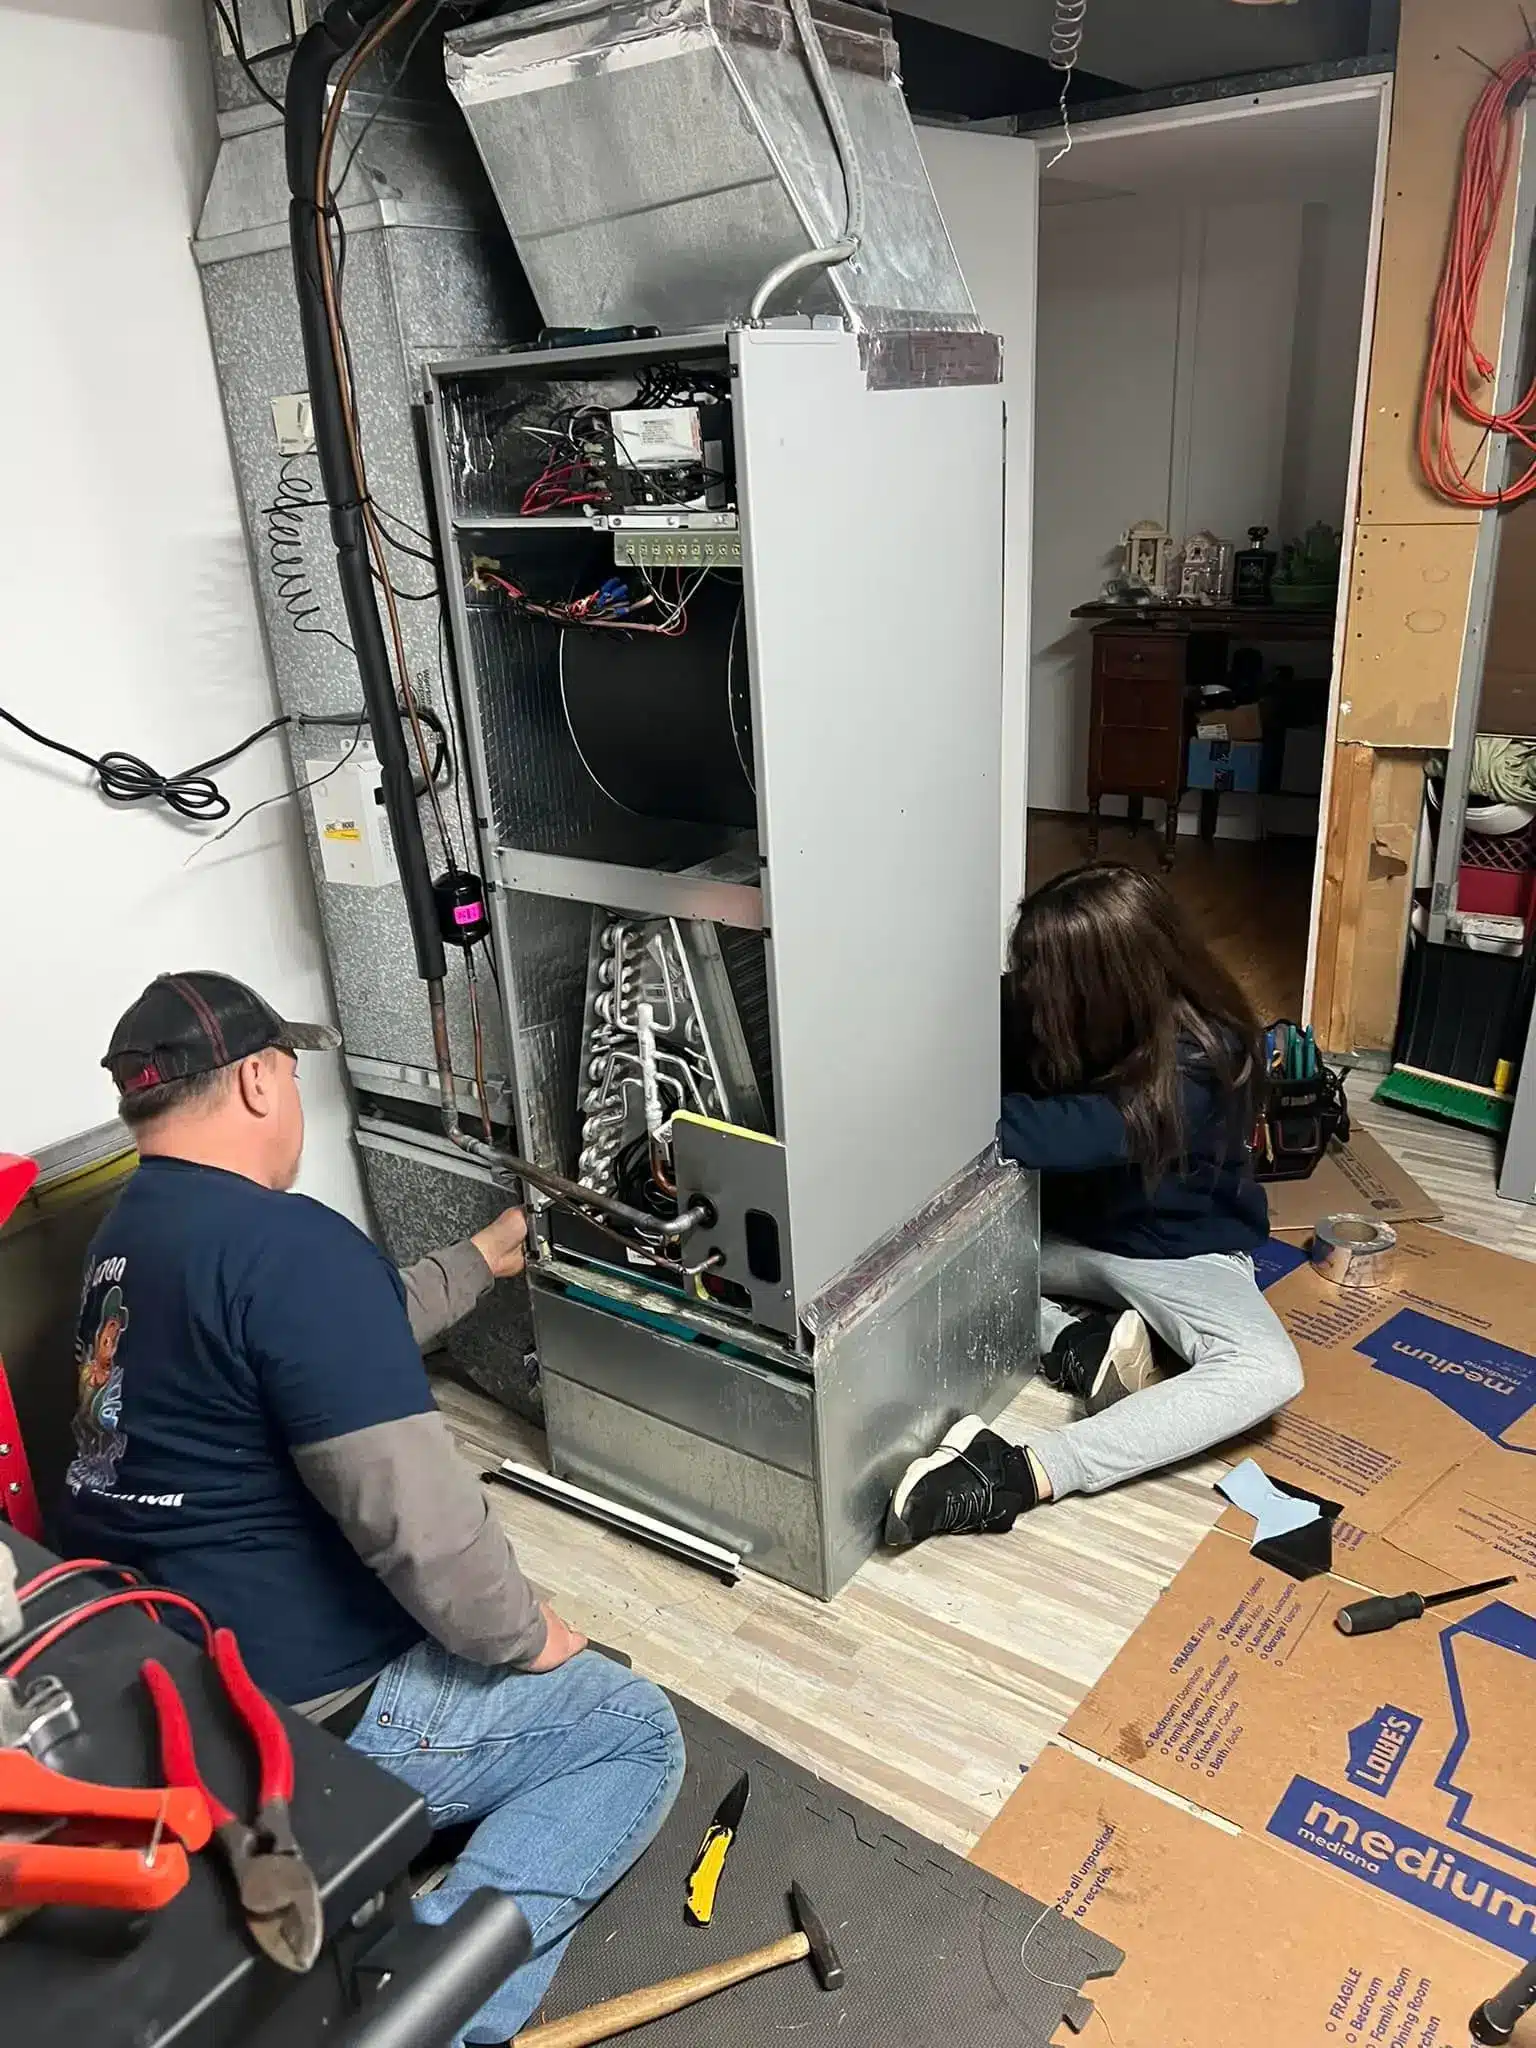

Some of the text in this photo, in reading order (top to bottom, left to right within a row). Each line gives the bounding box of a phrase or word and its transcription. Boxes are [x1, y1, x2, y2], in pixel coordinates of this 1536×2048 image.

[1391, 1340, 1517, 1396] medium
[1463, 1359, 1522, 1386] mediana
[1220, 1600, 1249, 1635] Basement
[1234, 1622, 1253, 1642] Attic
[1248, 1617, 1275, 1647] Laundry
[1174, 1636, 1201, 1668] FRAGILE
[1264, 1626, 1286, 1653] Garage
[1149, 1703, 1180, 1740] Bedroom
[1163, 1719, 1189, 1748] Family
[1181, 1697, 1204, 1721] Room
[1179, 1727, 1205, 1755] Dining
[1196, 1705, 1218, 1729] Room
[1193, 1730, 1221, 1763] Kitchen
[1209, 1749, 1229, 1770] Bath
[1355, 1715, 1412, 1786] LOWE'S
[1297, 1826, 1381, 1875] mediana
[1303, 1800, 1536, 1936] medium
[1070, 1873, 1084, 1890] all
[1073, 1905, 1087, 1917] to
[1329, 1967, 1362, 2021] FRAGILE
[1350, 1977, 1384, 2031] Bedroom
[1370, 1966, 1412, 2042] Family Room
[1407, 1978, 1432, 2012] Room
